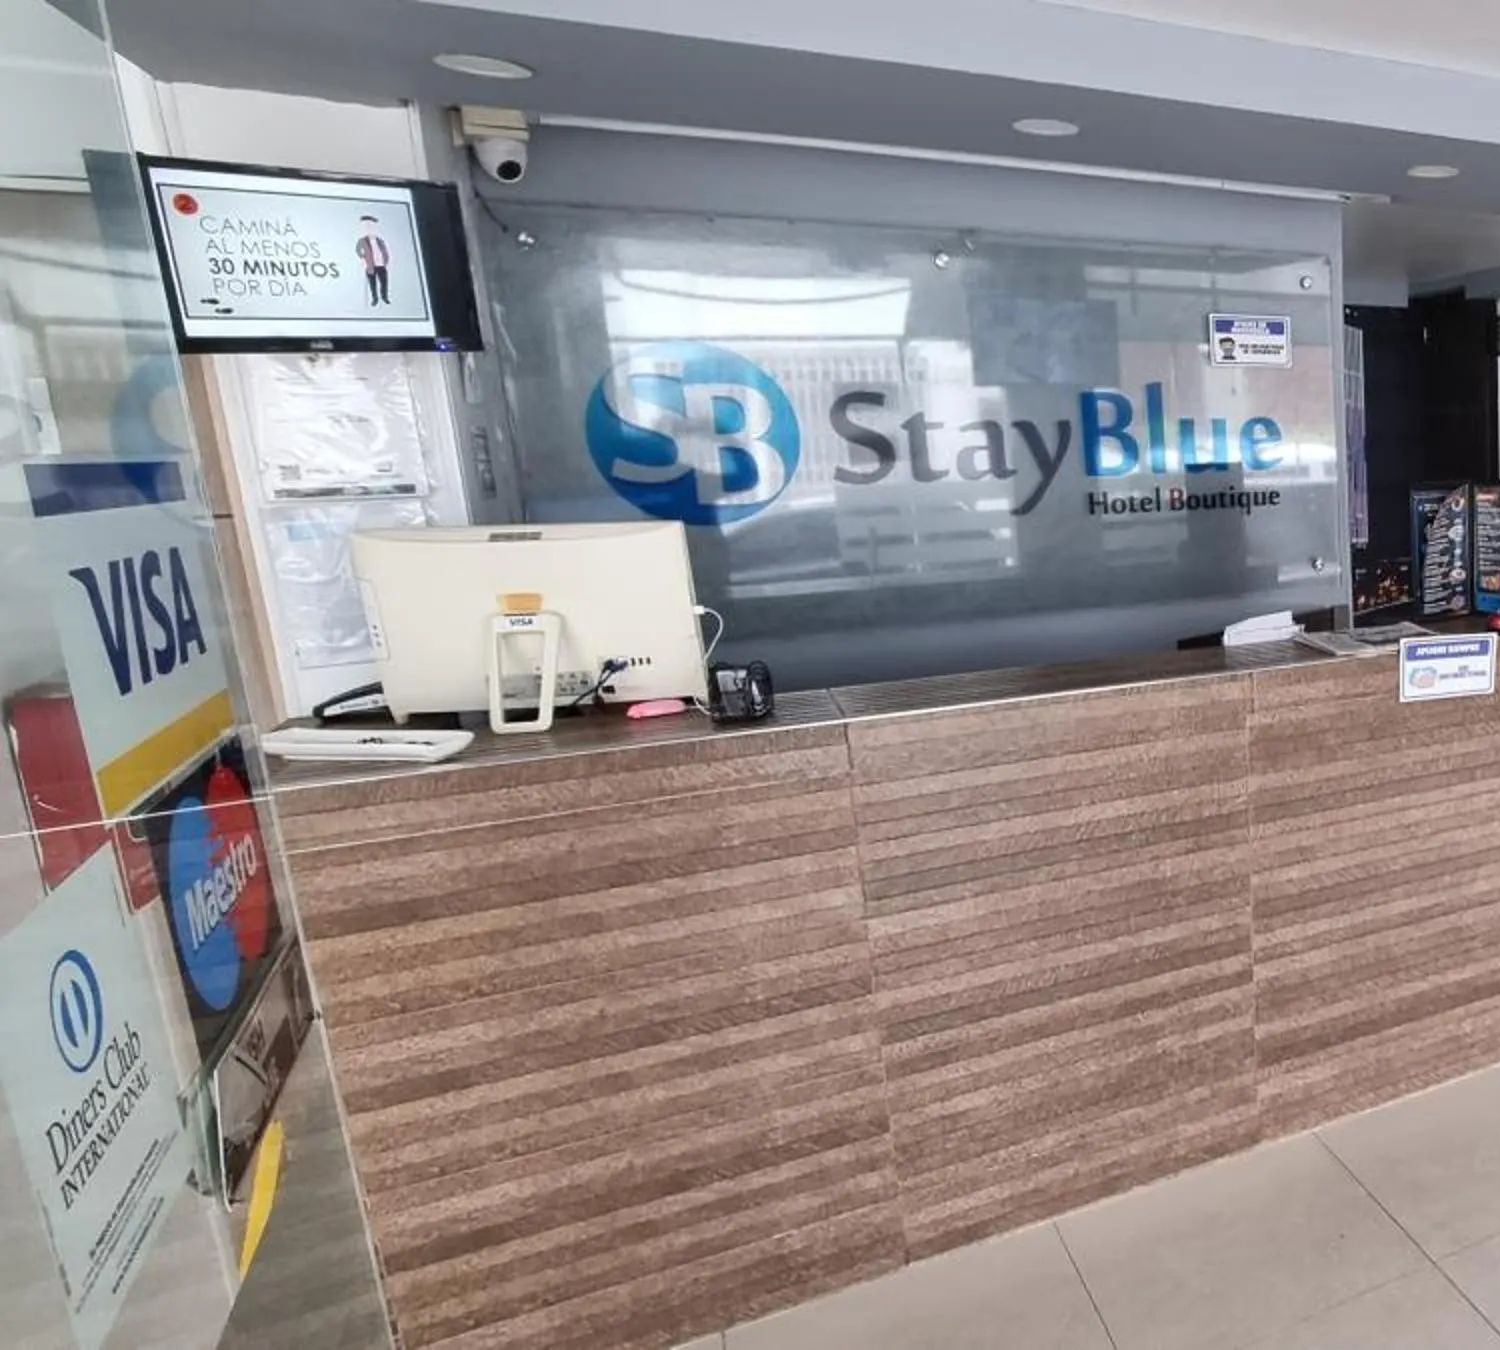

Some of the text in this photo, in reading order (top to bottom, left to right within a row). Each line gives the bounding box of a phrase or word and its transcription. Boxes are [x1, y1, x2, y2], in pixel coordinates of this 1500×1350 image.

[200, 214, 299, 237] CAMINÁ
[206, 238, 321, 259] AL MENOS
[209, 258, 340, 279] 30 MINUTOS
[213, 278, 308, 297] POR DÍA
[1087, 485, 1281, 515] Hotel Boutique
[68, 546, 207, 697] VISA
[184, 834, 258, 949] Maestro
[46, 1079, 107, 1175] Diners
[104, 1020, 141, 1090] Club
[60, 1062, 150, 1211] INTERNATIONAL
